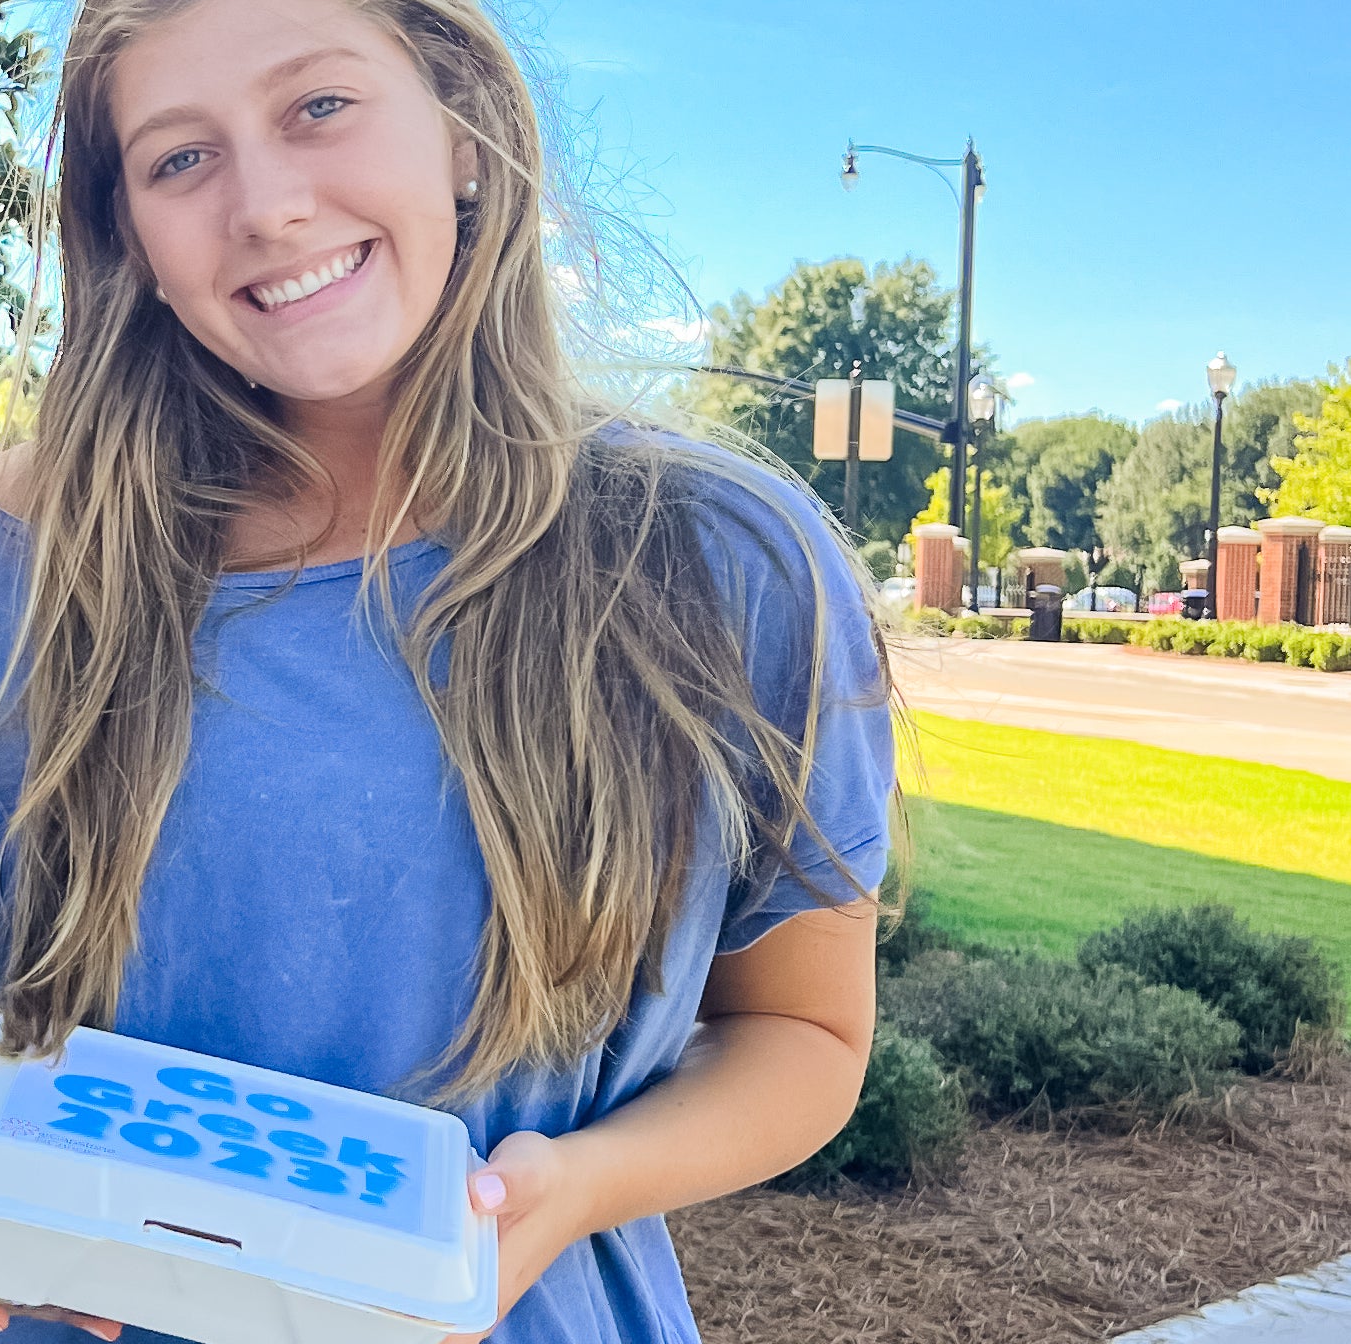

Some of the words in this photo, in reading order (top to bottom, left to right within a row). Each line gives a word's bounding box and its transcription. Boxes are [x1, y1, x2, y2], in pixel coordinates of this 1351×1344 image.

[53, 1074, 407, 1179] Greek
[156, 1066, 314, 1123] Go
[46, 1101, 405, 1207] 2023!
